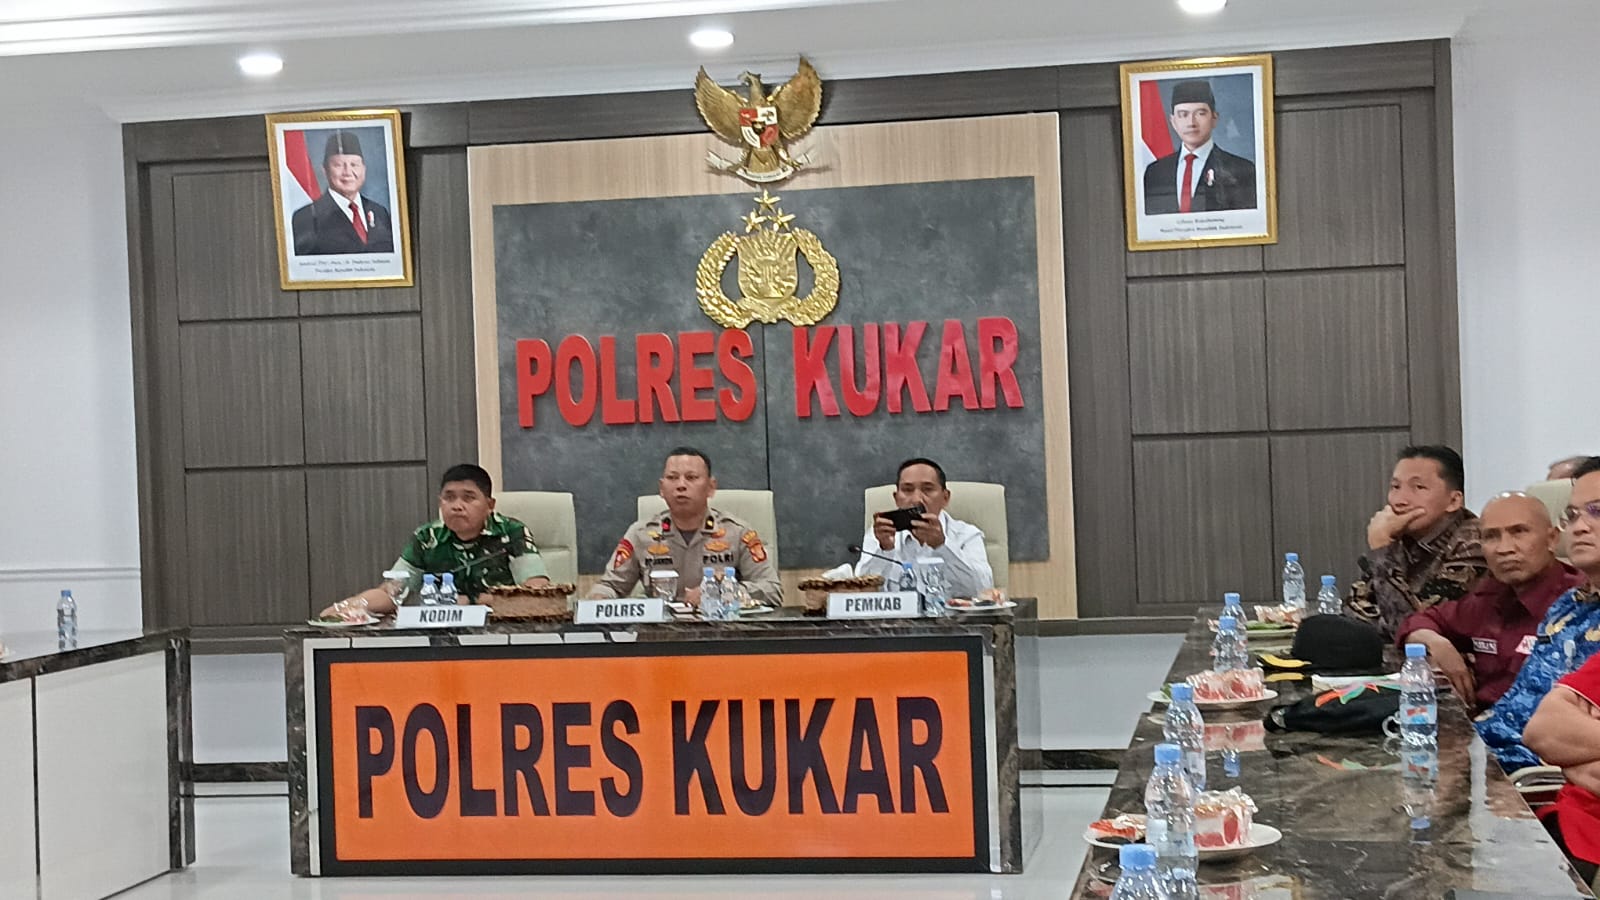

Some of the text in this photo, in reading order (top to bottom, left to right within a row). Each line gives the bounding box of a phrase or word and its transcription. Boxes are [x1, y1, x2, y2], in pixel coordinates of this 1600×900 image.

[516, 316, 1024, 427] POLRES KUKAR
[703, 553, 734, 565] POLRI
[596, 603, 645, 618] POLRES
[845, 596, 902, 612] PEMKAB
[419, 609, 463, 623] KODIM
[355, 696, 949, 819] POLRES KUKAR
